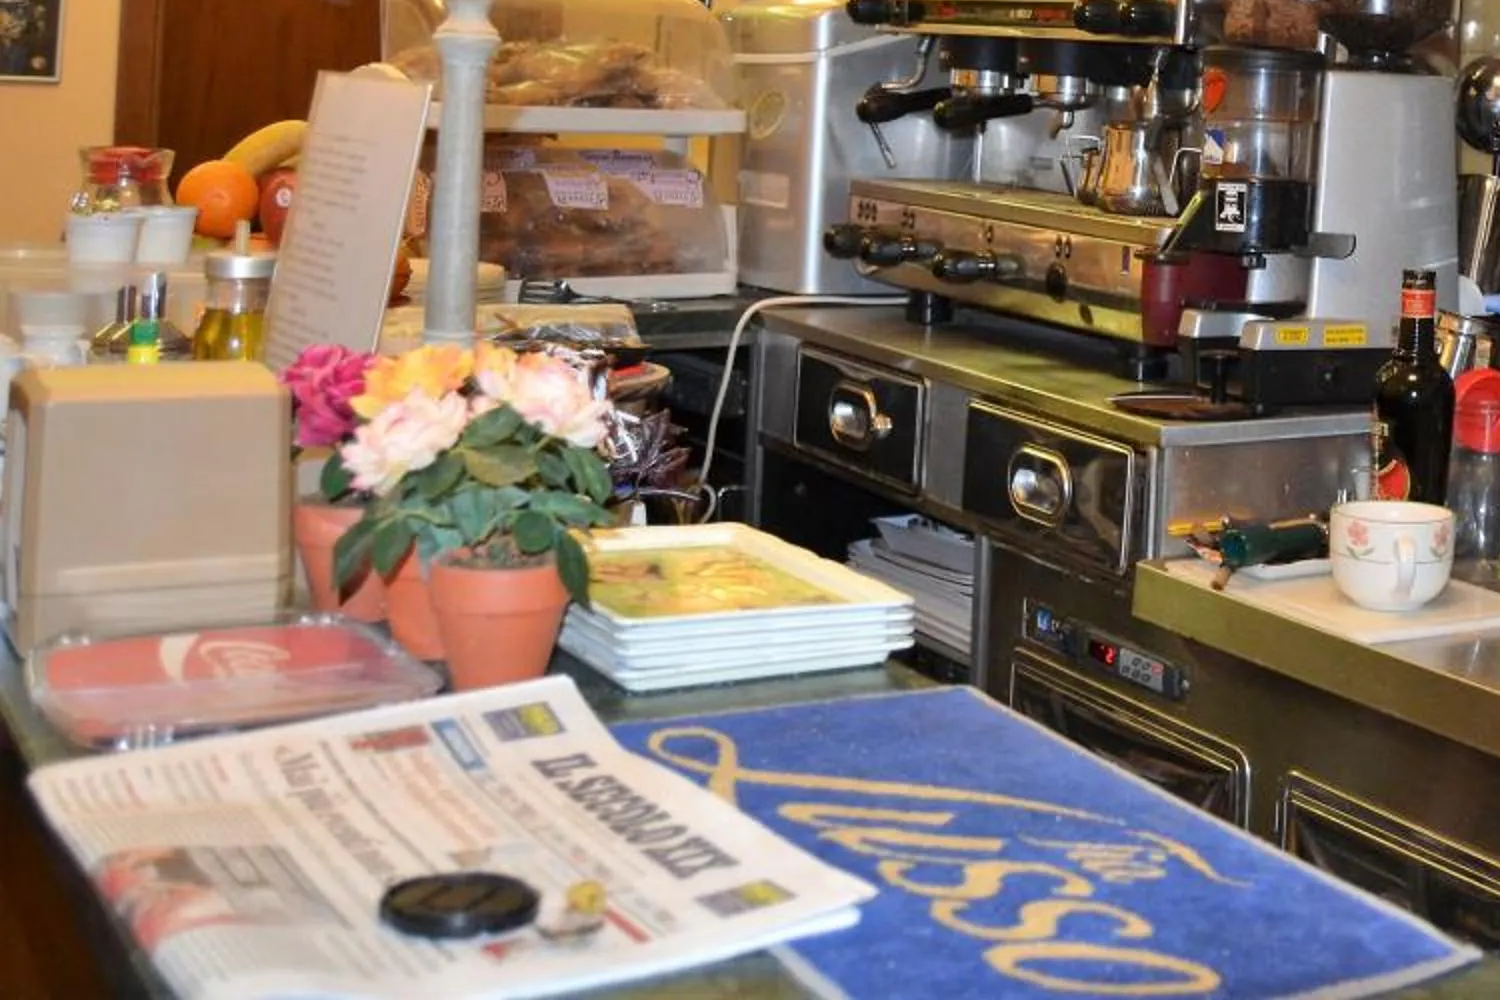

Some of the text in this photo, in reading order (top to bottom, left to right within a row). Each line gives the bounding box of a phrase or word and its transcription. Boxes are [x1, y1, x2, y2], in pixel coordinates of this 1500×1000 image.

[530, 752, 741, 881] IL SECOLO XIX
